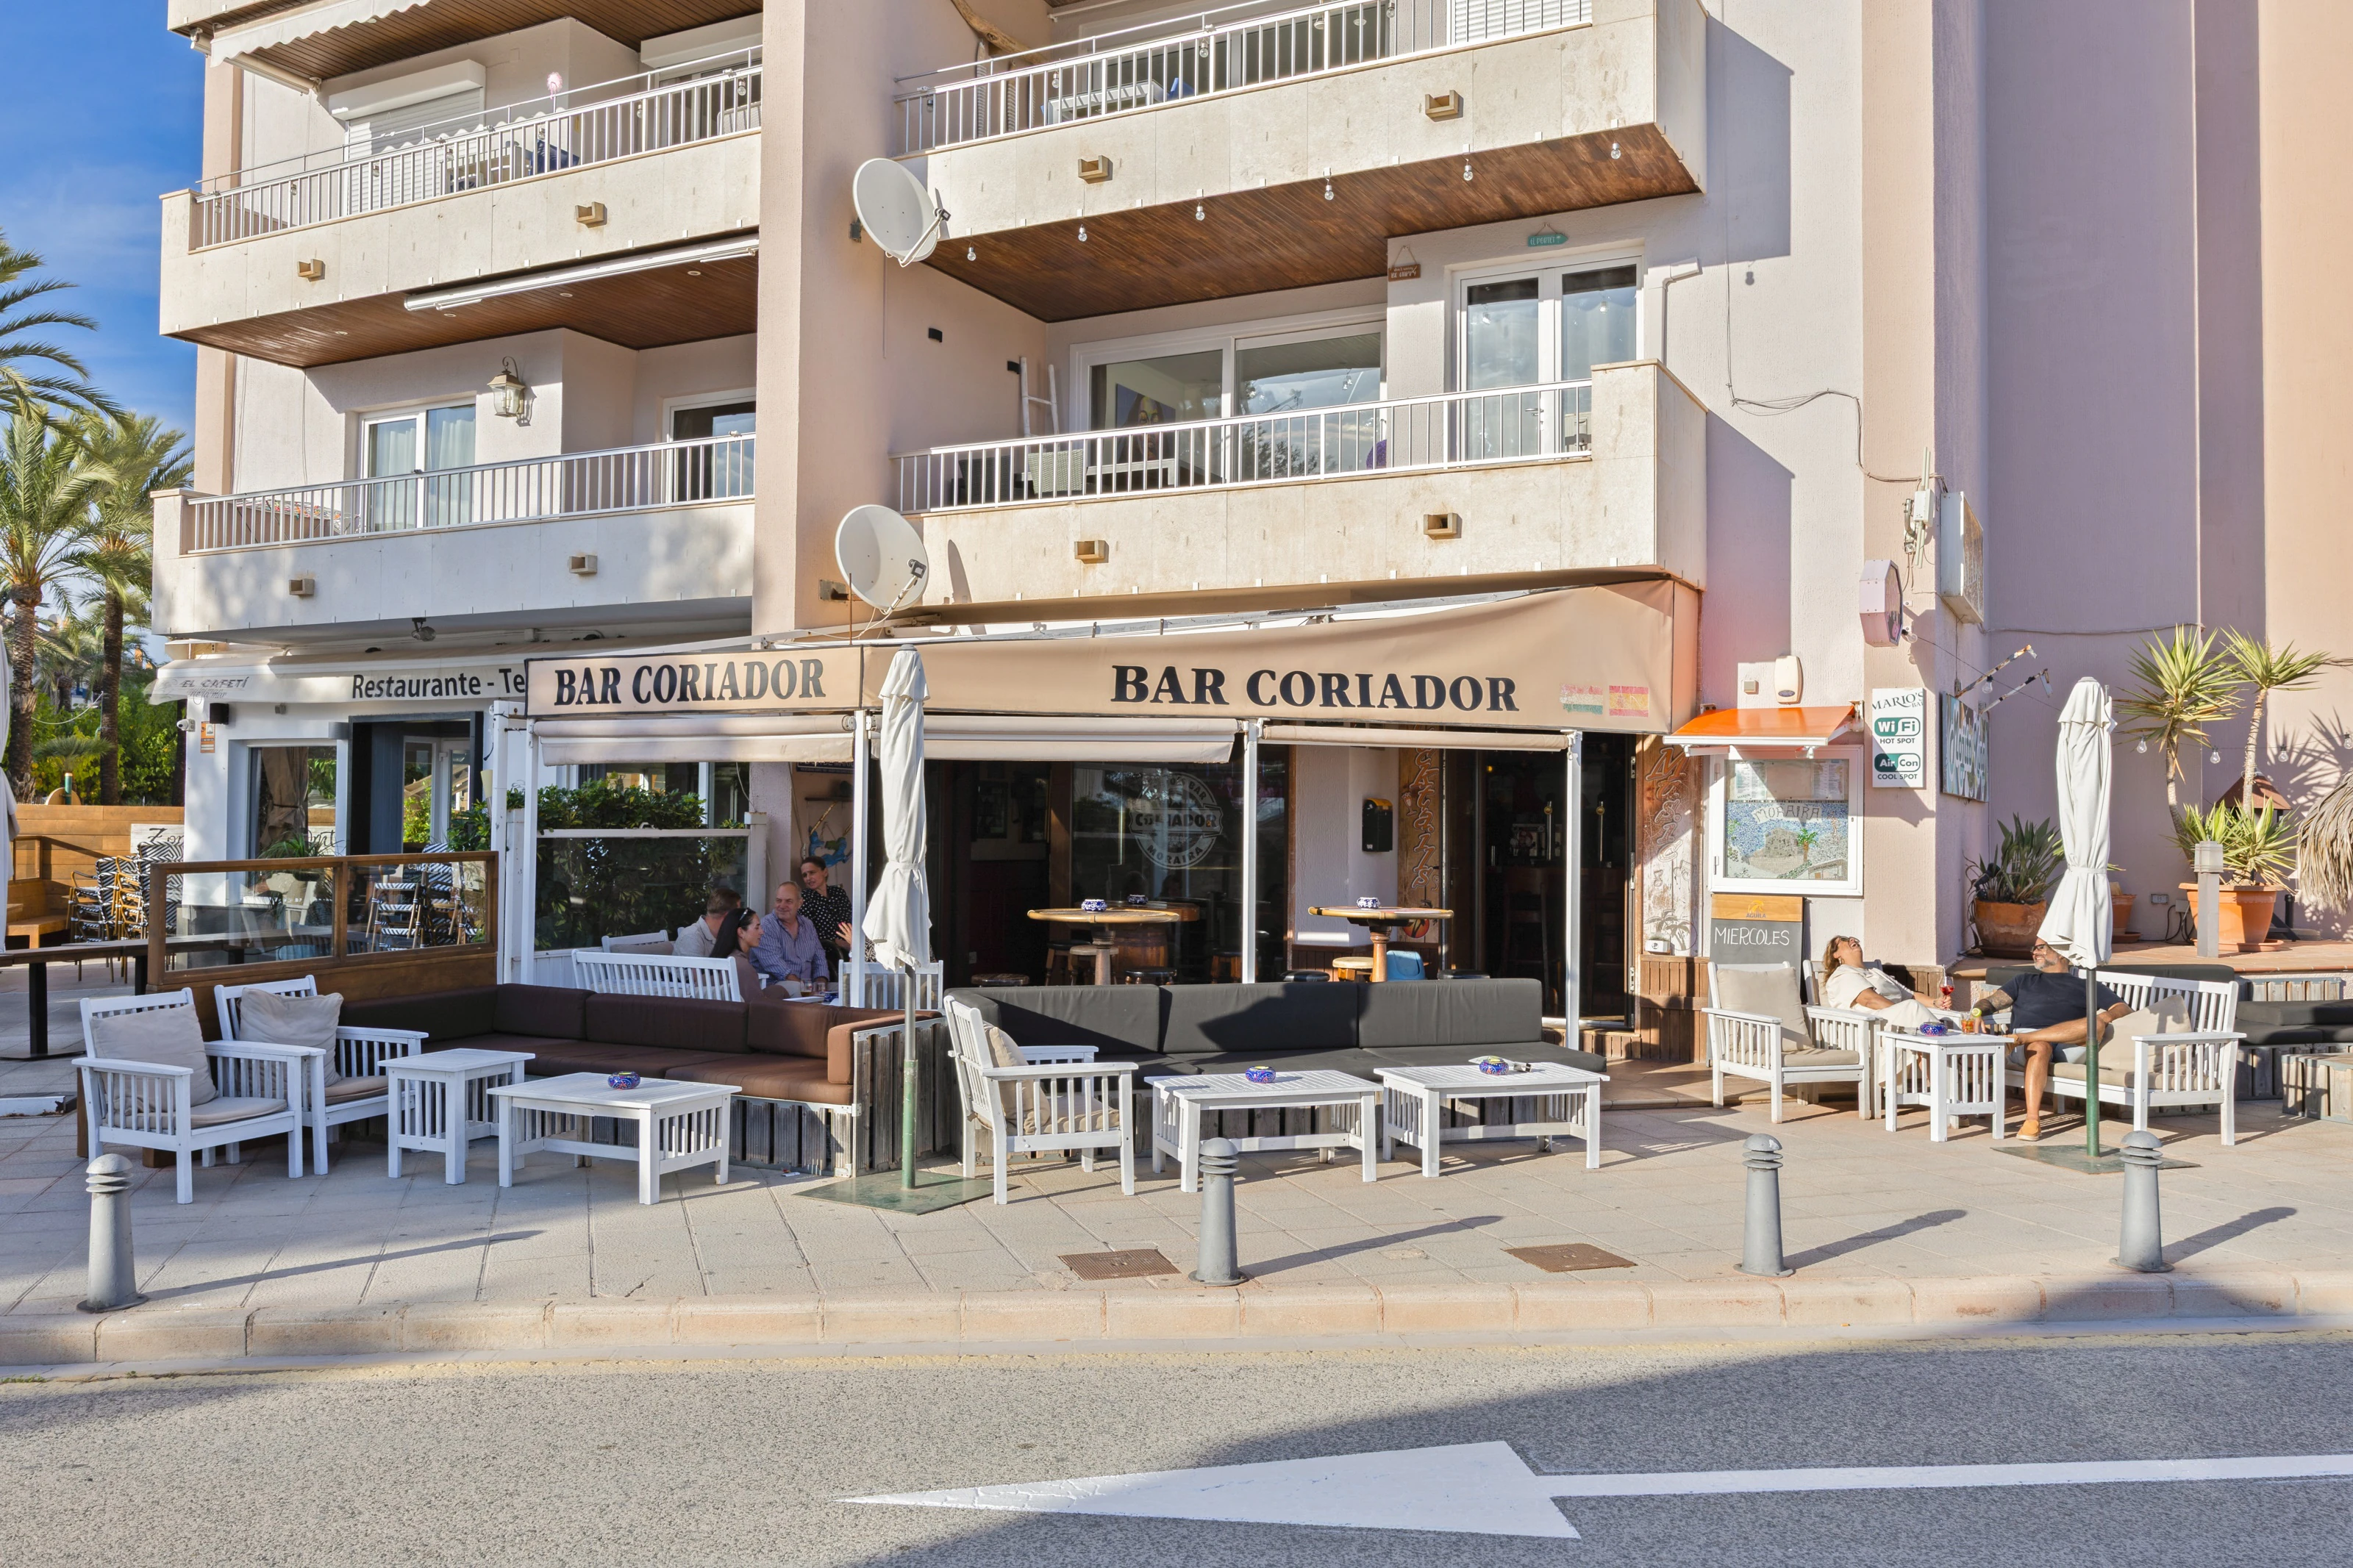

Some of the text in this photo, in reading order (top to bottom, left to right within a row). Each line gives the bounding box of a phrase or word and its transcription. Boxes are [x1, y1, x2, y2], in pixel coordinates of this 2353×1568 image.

[182, 680, 194, 688] EL
[352, 673, 481, 698] Restaurante
[554, 659, 826, 706] BAR CORIADOR
[1110, 665, 1520, 712] BAR CORIADOR
[1872, 692, 1924, 710] MARIO'S
[1879, 759, 1918, 767] Air Con
[1188, 781, 1207, 801] BAR
[1147, 844, 1202, 864] MORAIRA
[1715, 926, 1790, 946] MIERCOLES
